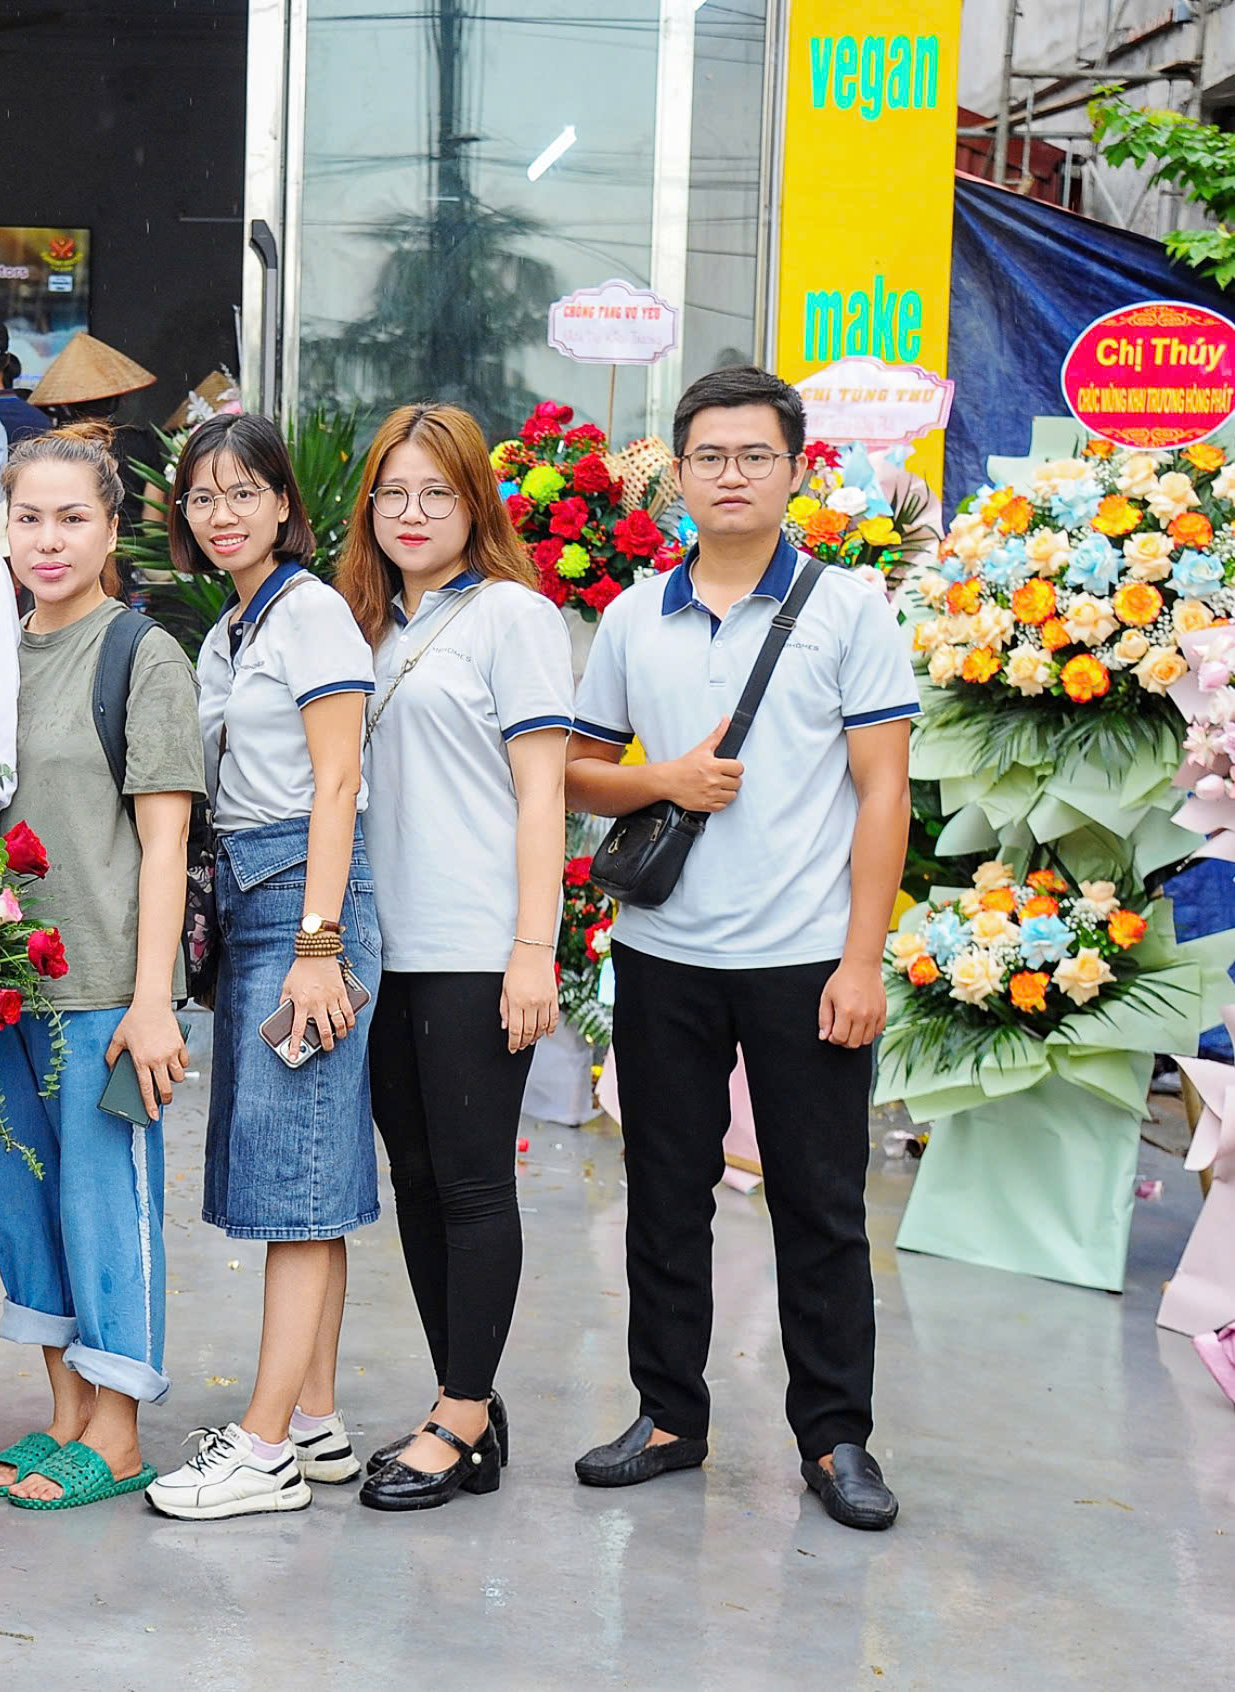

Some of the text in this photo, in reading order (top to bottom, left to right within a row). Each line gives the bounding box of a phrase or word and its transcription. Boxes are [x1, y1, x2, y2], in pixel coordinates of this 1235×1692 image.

[809, 34, 939, 120] vegan
[804, 274, 923, 362] make
[1096, 336, 1227, 372] Chị Thúy
